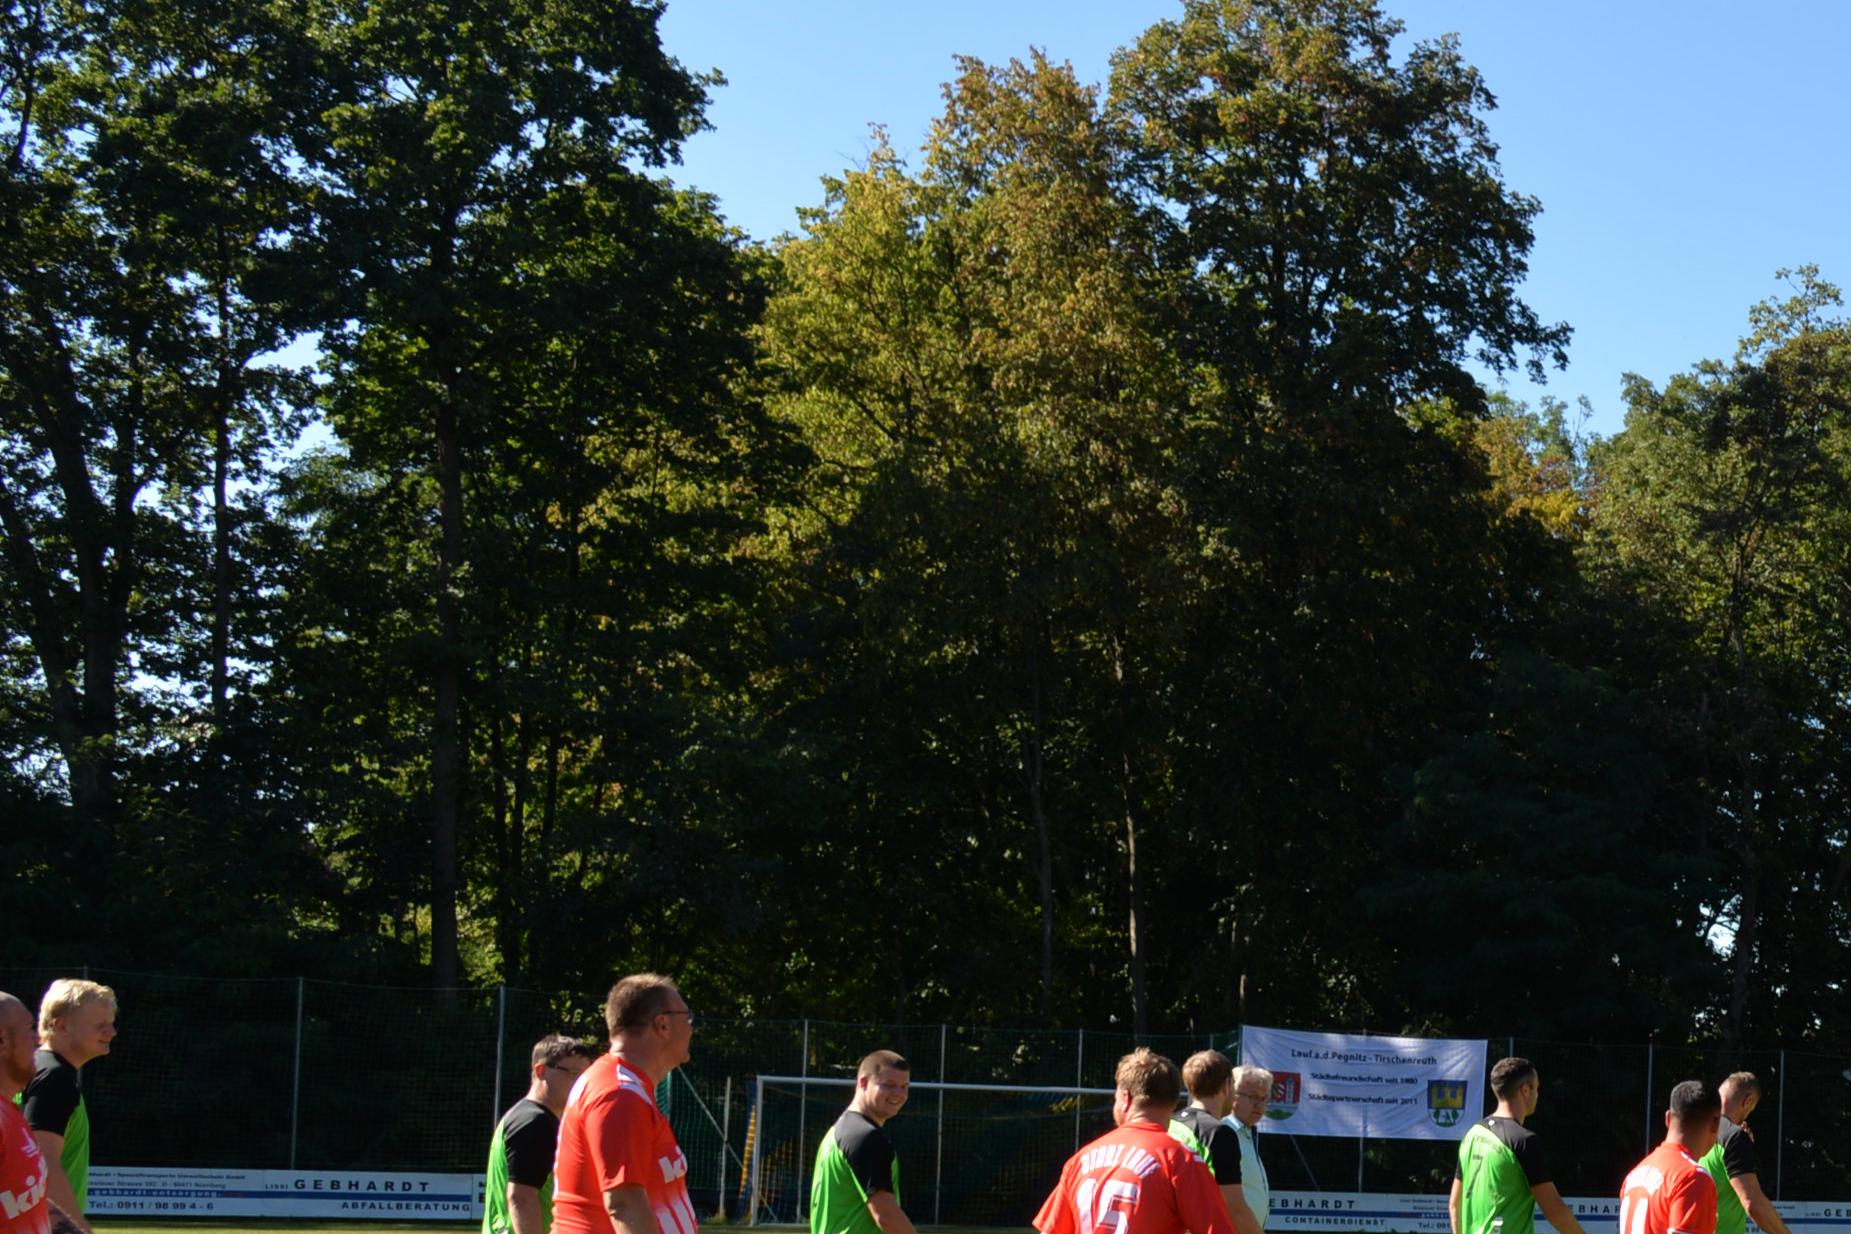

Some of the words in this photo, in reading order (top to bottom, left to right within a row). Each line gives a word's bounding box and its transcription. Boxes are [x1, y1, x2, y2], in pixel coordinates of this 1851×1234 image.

[1374, 1053, 1437, 1065] Tirschenreuth
[1310, 1073, 1383, 1084] Städtefreundschaft
[1308, 1093, 1383, 1105] Städtepartnerschaft
[294, 1178, 430, 1192] GEBHARDT
[90, 1201, 113, 1209] Tel.:
[117, 1202, 144, 1210] 0911
[341, 1201, 470, 1211] ABFALLBERATUNG
[1269, 1199, 1355, 1209] EBHARDT
[1285, 1217, 1385, 1226] CONTAINERDIENST
